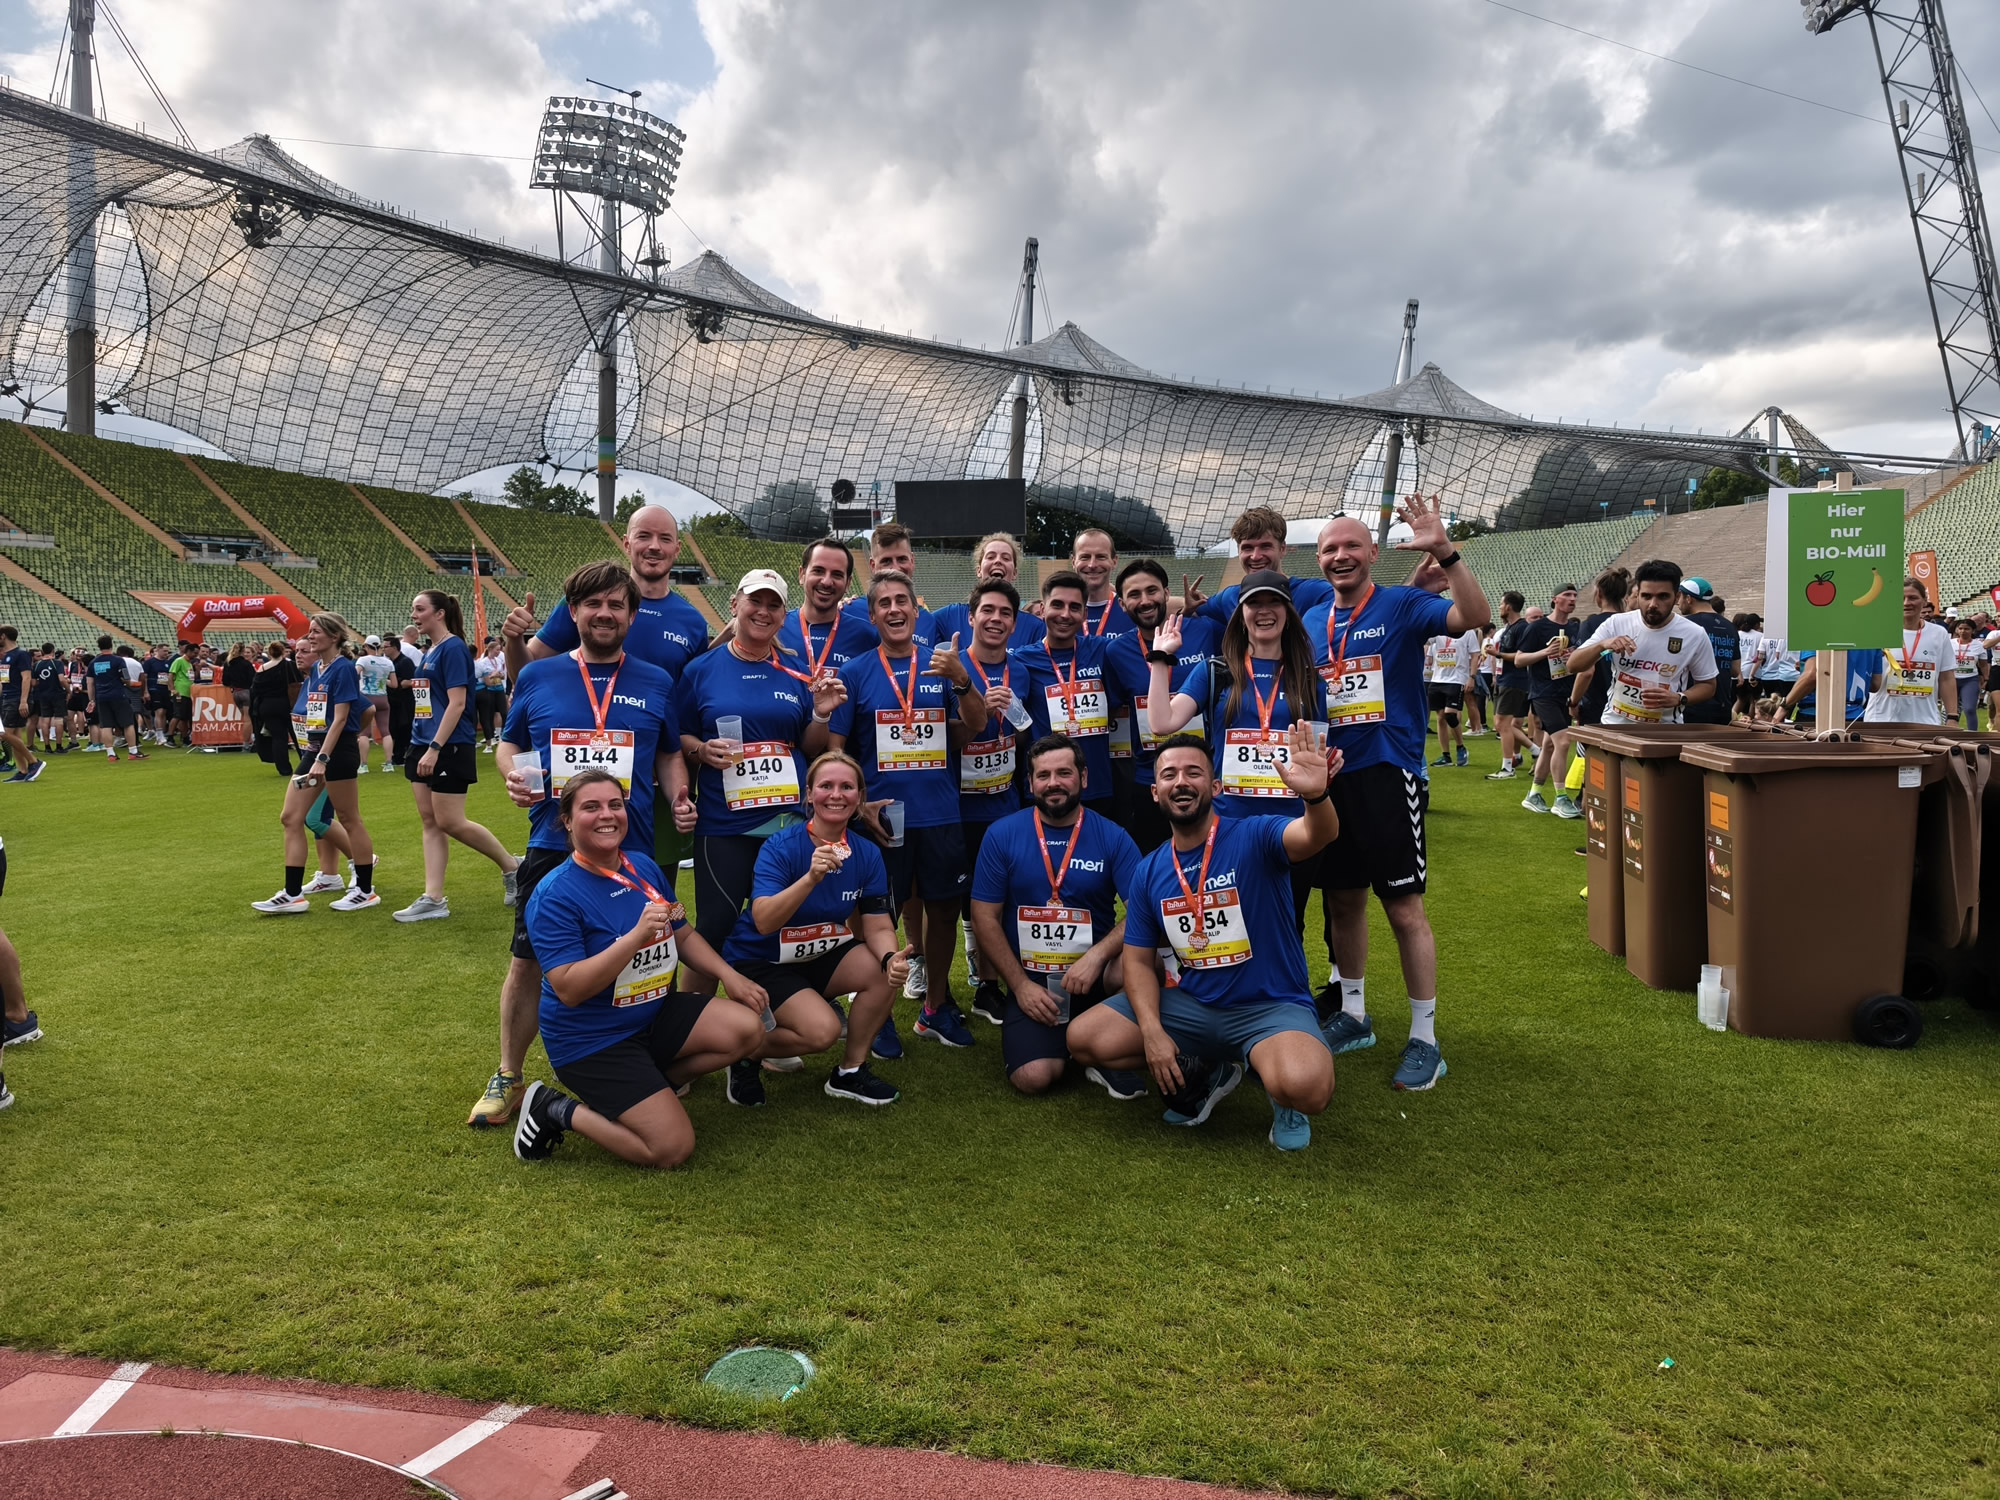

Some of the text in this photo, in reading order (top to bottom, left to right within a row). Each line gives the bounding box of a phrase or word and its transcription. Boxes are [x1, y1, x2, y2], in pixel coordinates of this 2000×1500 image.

[1827, 503, 1865, 517] Hier
[1831, 527, 1862, 538] nur
[1806, 544, 1886, 560] BIO-Müll
[182, 612, 197, 628] ZIEL
[273, 608, 289, 624] ZIEL
[1354, 624, 1385, 640] meri
[1179, 651, 1204, 666] meri
[1619, 658, 1677, 673] CHECK24
[1078, 664, 1102, 677] meri
[613, 695, 646, 708] meri
[890, 724, 933, 740] 849
[565, 747, 618, 764] 8144
[974, 751, 1009, 769] 8138
[736, 757, 782, 777] 8140
[1070, 858, 1104, 872] meri
[1204, 869, 1236, 891] meri
[1388, 875, 1415, 887] hummel
[610, 887, 627, 897] CRAFT
[1031, 923, 1077, 940] 8147
[632, 942, 670, 970] 8141
[794, 938, 840, 958] 8137
[638, 962, 662, 975] DOMINIKA
